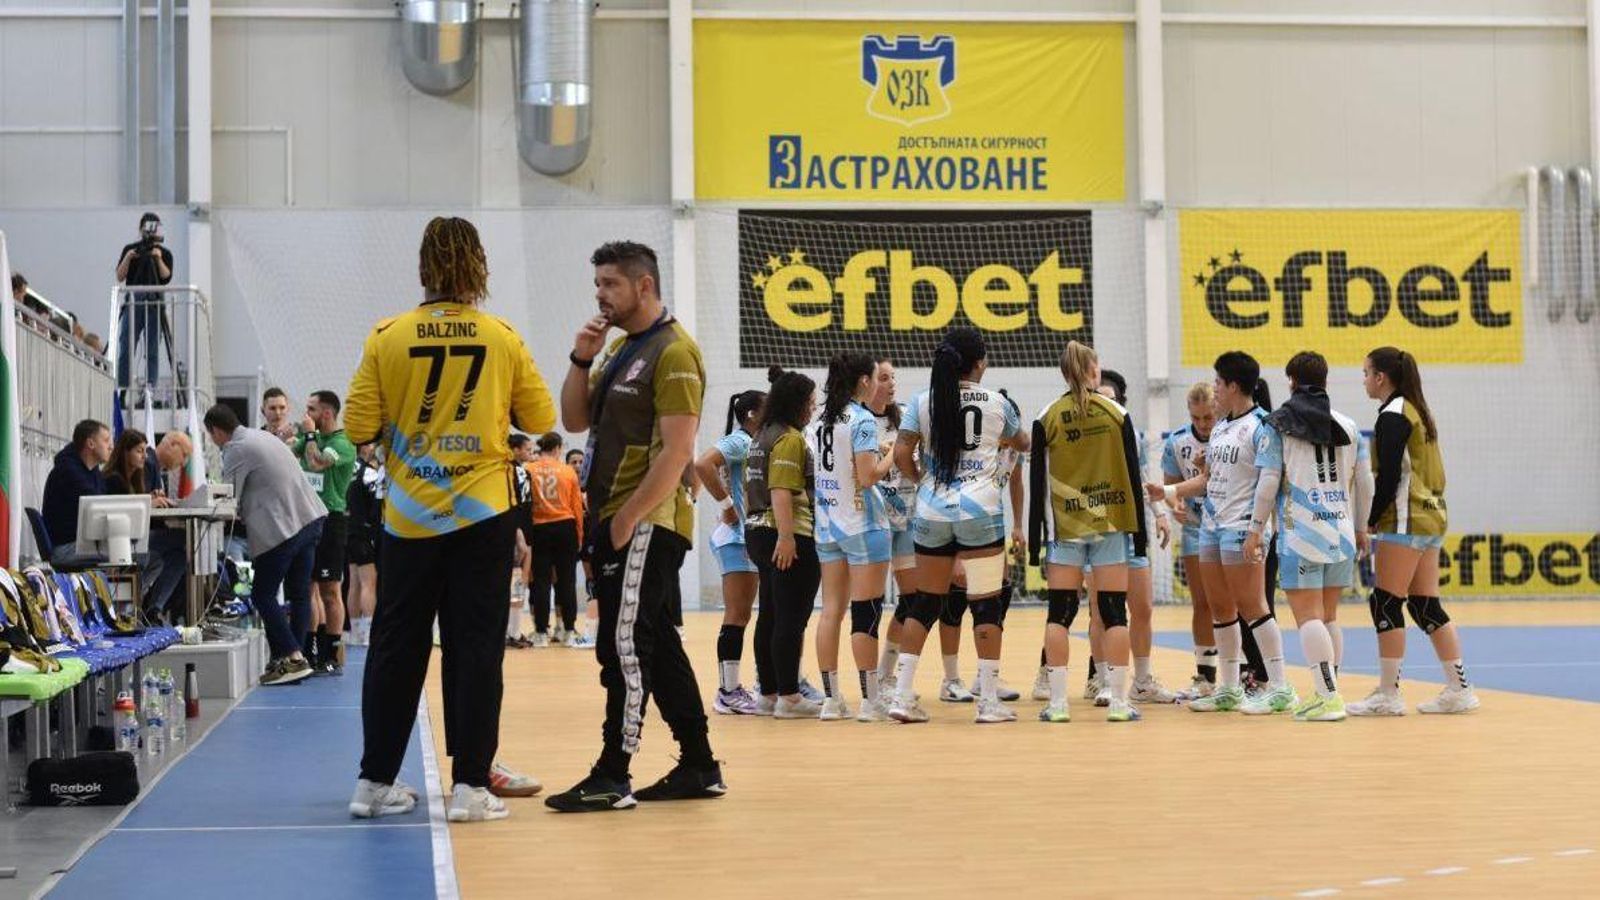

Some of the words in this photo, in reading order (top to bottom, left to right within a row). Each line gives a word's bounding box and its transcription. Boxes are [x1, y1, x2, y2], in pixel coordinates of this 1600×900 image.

[886, 68, 930, 110] ОЗК
[898, 136, 978, 150] ДОСТЪПНАТА
[981, 136, 1047, 149] СИГУРНОСТ
[763, 249, 1084, 331] efbet
[1204, 250, 1512, 329] efbet
[417, 322, 477, 339] BALZINC
[408, 345, 487, 424] 77
[436, 434, 483, 453] TESOL
[816, 425, 834, 472] 18
[1313, 443, 1338, 483] 11
[960, 461, 984, 470] ESOL
[50, 782, 102, 794] Reebok
